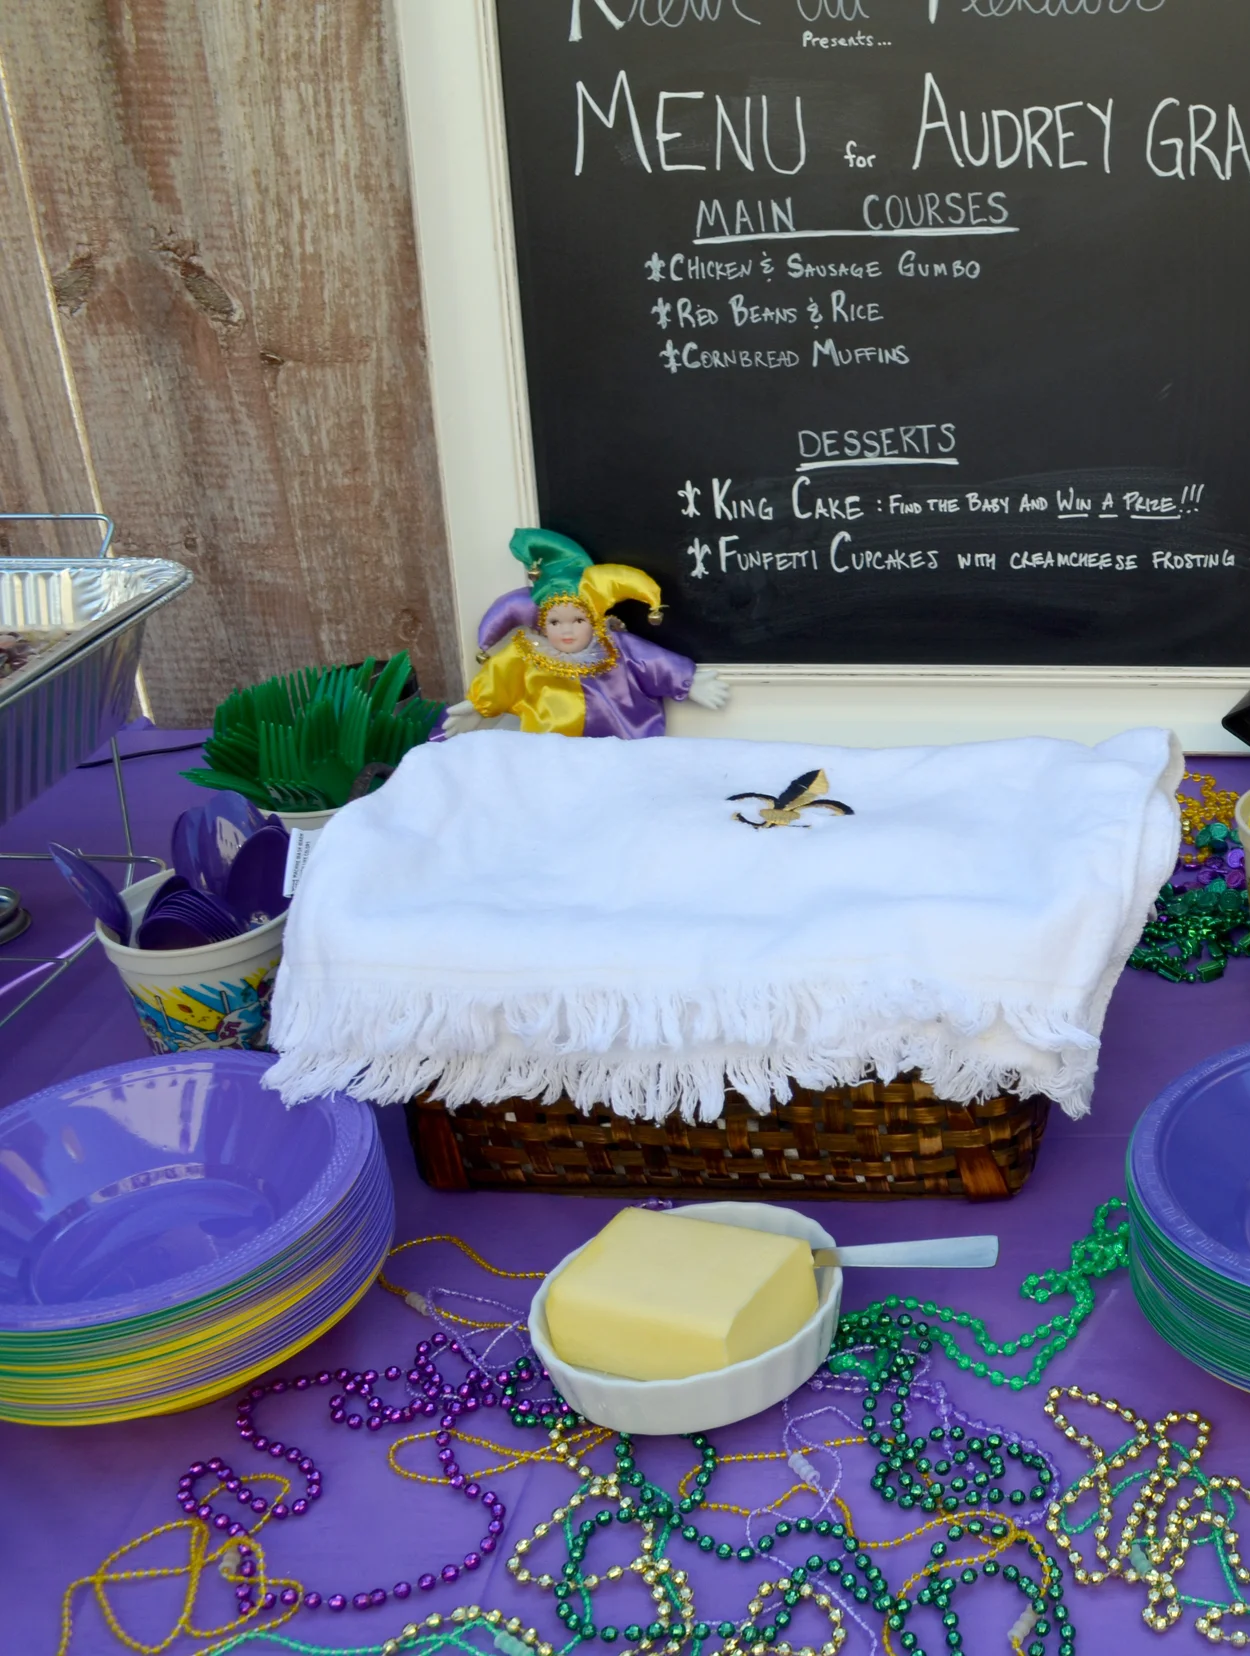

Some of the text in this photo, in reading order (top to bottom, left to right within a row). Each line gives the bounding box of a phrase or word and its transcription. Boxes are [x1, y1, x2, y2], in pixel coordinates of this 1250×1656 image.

[802, 30, 892, 48] Presents...
[574, 70, 806, 175] MENU
[843, 140, 876, 168] for
[912, 72, 1113, 173] AUDREY
[695, 192, 1009, 237] MAIN COURSES
[670, 253, 752, 282] CHICKEN
[787, 253, 882, 279] SAUSAGE
[898, 250, 981, 278] GUMBO
[676, 298, 719, 328] RED
[729, 294, 797, 326] BEANS
[830, 289, 884, 323] RICE
[682, 338, 910, 369] CORNBREAD MUFFINS
[798, 423, 956, 458] DESSERTS
[711, 477, 774, 520] KING
[889, 494, 922, 514] FIND
[927, 499, 960, 513] THE
[966, 493, 1009, 513] BABY
[1019, 494, 1048, 513] AND
[1057, 487, 1092, 512] WIN
[1101, 493, 1114, 510] A
[718, 535, 818, 573] FUNFETTI
[830, 531, 939, 573] CUPCAKES
[957, 553, 996, 570] WITH
[1151, 550, 1236, 570] FROSTING
